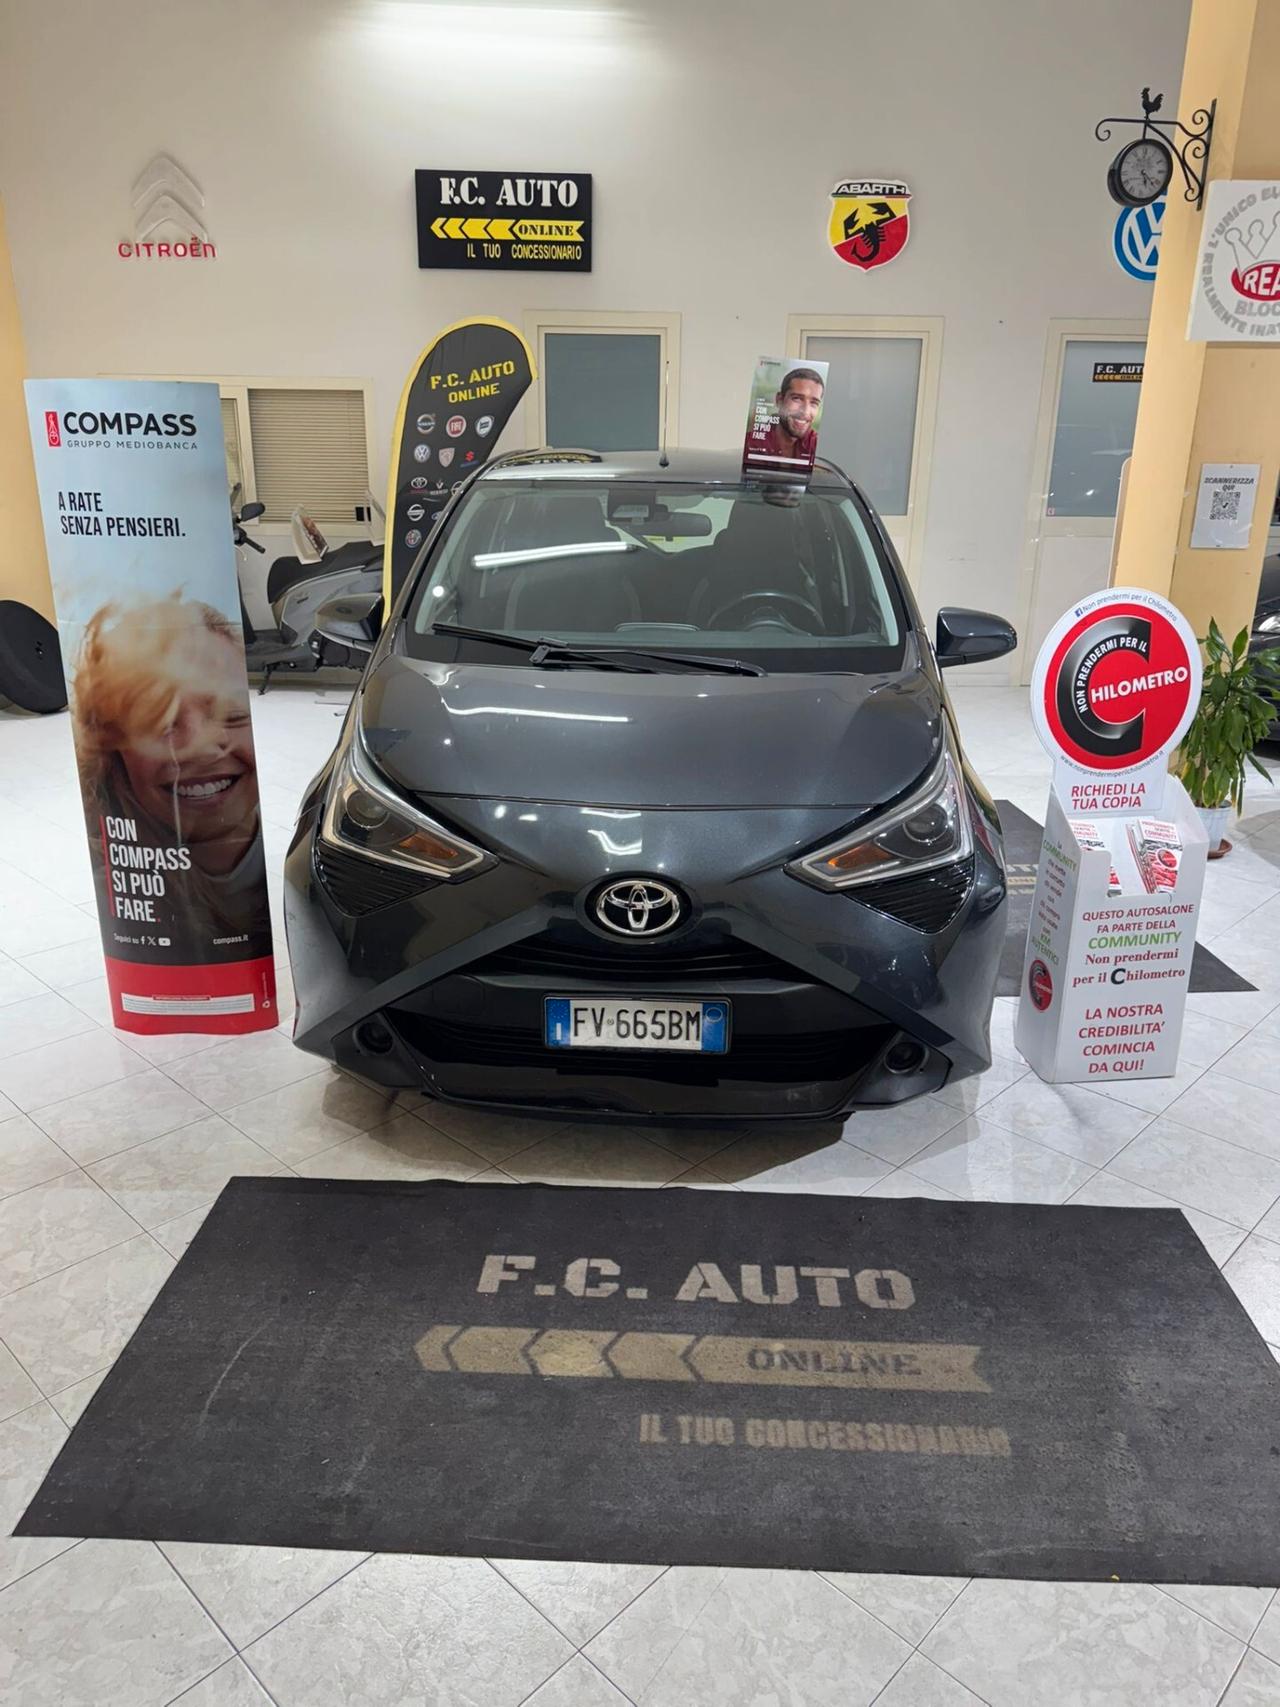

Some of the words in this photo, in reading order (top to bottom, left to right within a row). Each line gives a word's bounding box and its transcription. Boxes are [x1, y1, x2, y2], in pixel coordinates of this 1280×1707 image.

[439, 176, 486, 205] F.C.
[496, 178, 578, 207] AUTO
[838, 184, 905, 194] ABARTH
[518, 224, 574, 237] ONLINE
[467, 243, 476, 258] IL
[483, 243, 501, 259] TUO
[511, 244, 582, 260] CONCESSIONARIO
[431, 373, 465, 390] F.C.
[469, 360, 515, 384] AUTO
[1096, 364, 1116, 374] F.C.
[1120, 365, 1143, 374] AUT
[448, 382, 500, 404] ONLINE
[64, 411, 197, 437] COMPASS
[755, 414, 780, 424] COMPASS
[67, 440, 111, 449] GRUPPO
[116, 441, 198, 450] MEDIOBANCA
[58, 491, 66, 511] A
[69, 492, 103, 512] RATE
[61, 516, 103, 536] SENZA
[106, 517, 186, 537] PENSIERI.
[1120, 637, 1138, 649] PER
[1138, 641, 1147, 653] IL
[1077, 639, 1117, 687] PRENDERMI
[1077, 690, 1088, 713] NON
[1071, 783, 1126, 797] RICHIEDI
[1130, 783, 1146, 794] LA
[1072, 798, 1098, 810] TUA
[1102, 796, 1141, 808] COPIA
[106, 816, 138, 841] CON
[109, 843, 192, 870] COMPASS
[112, 870, 127, 893] SI
[130, 869, 165, 896] PUÒ
[1082, 909, 1124, 921] QUESTO
[1127, 904, 1195, 918] AUTOSALONE
[1097, 925, 1109, 934] FA
[1112, 922, 1143, 932] PARTE
[1146, 919, 1176, 930] DELLA
[213, 934, 249, 945] compass.it
[1088, 931, 1182, 949] COMMUNITY
[1085, 954, 1110, 965] Non
[1113, 949, 1179, 966] prendermi
[1072, 974, 1094, 987] per
[1098, 972, 1107, 983] il
[1110, 968, 1185, 985] Chilometro
[1085, 1008, 1102, 1020] LA
[1107, 1004, 1163, 1019] NOSTRA
[1083, 1041, 1155, 1056] COMINCIA
[1089, 1063, 1108, 1073] DA
[1113, 1059, 1144, 1072] QUI!
[476, 1254, 649, 1300] F.C.
[675, 1262, 917, 1311] AUTO
[747, 1347, 922, 1377] ONLINE
[639, 1413, 668, 1445] IL
[678, 1414, 735, 1447] TUO
